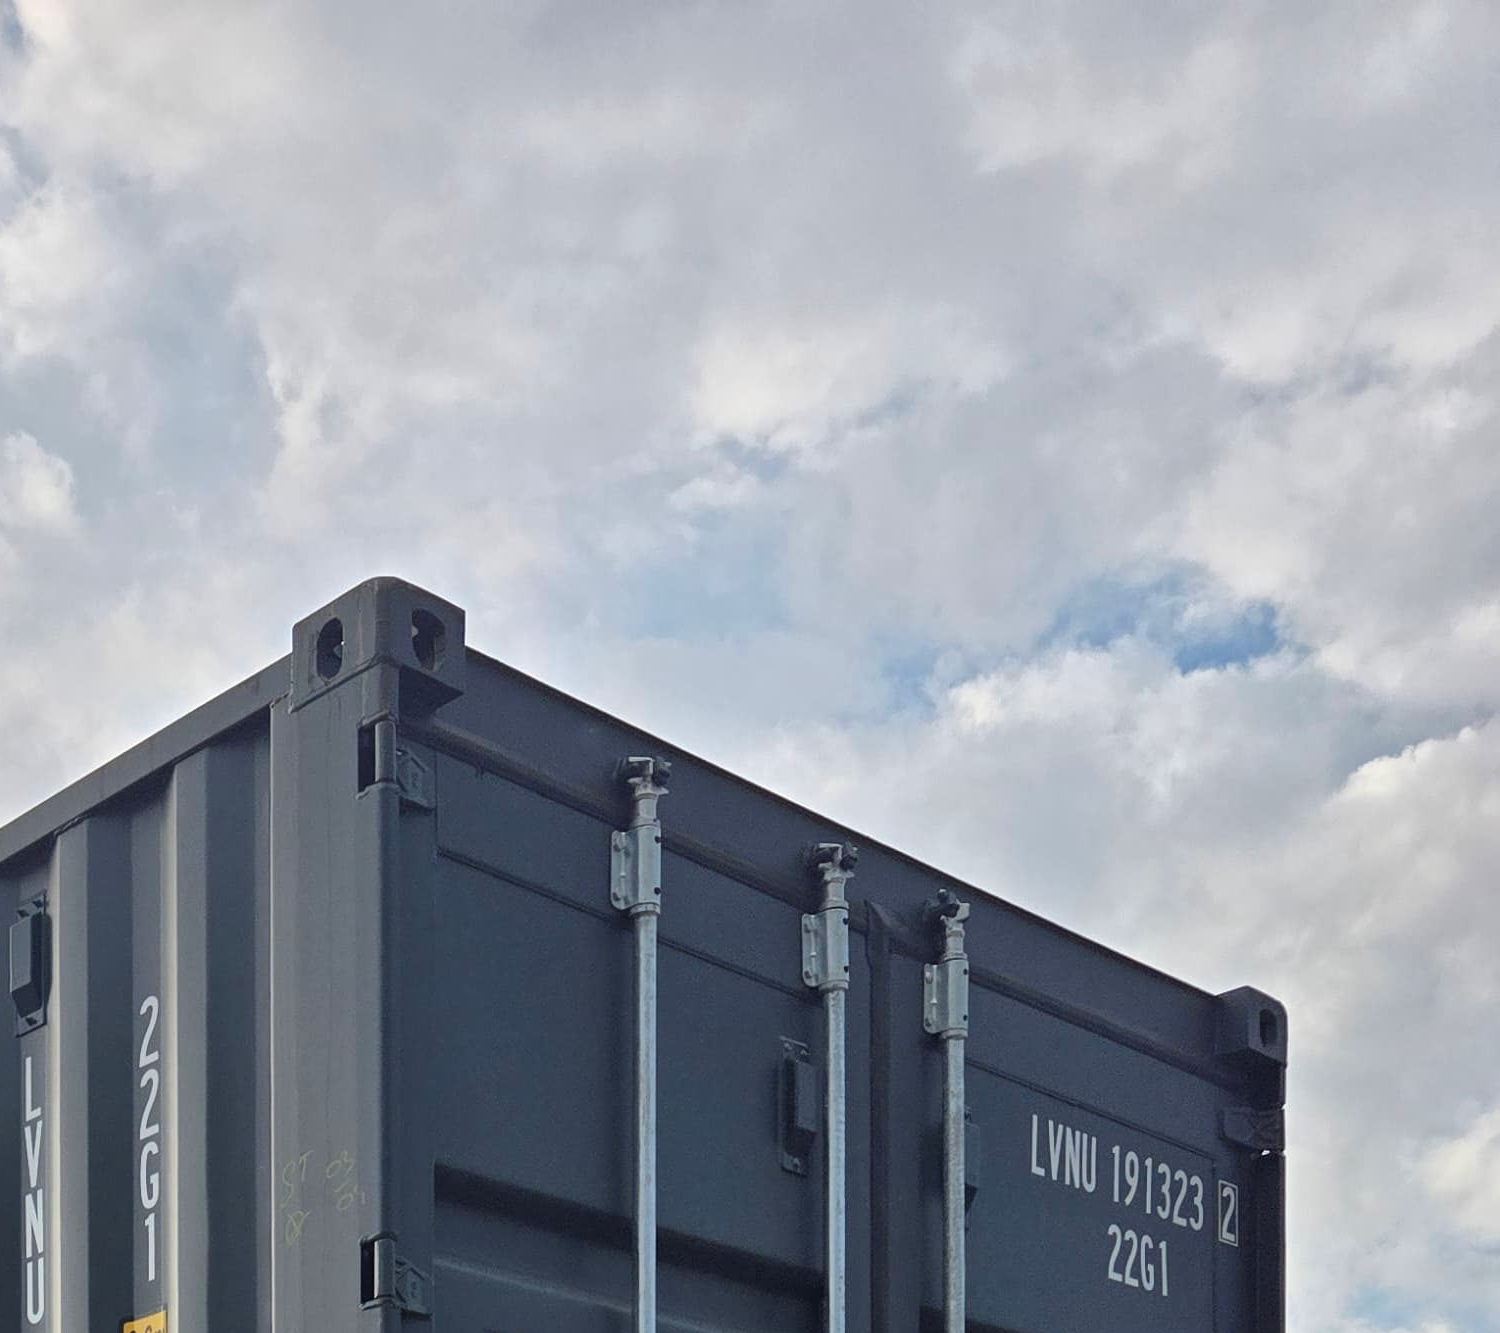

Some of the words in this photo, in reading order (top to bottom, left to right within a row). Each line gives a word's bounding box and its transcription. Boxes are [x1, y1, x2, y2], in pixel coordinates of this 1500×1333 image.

[24, 1056, 45, 1324] LVNU
[138, 995, 160, 1281] 22G1
[1031, 1114, 1097, 1193] LVNU
[1112, 1145, 1204, 1231] 191323
[1221, 1186, 1235, 1241] 2
[1107, 1224, 1168, 1297] 22G1
